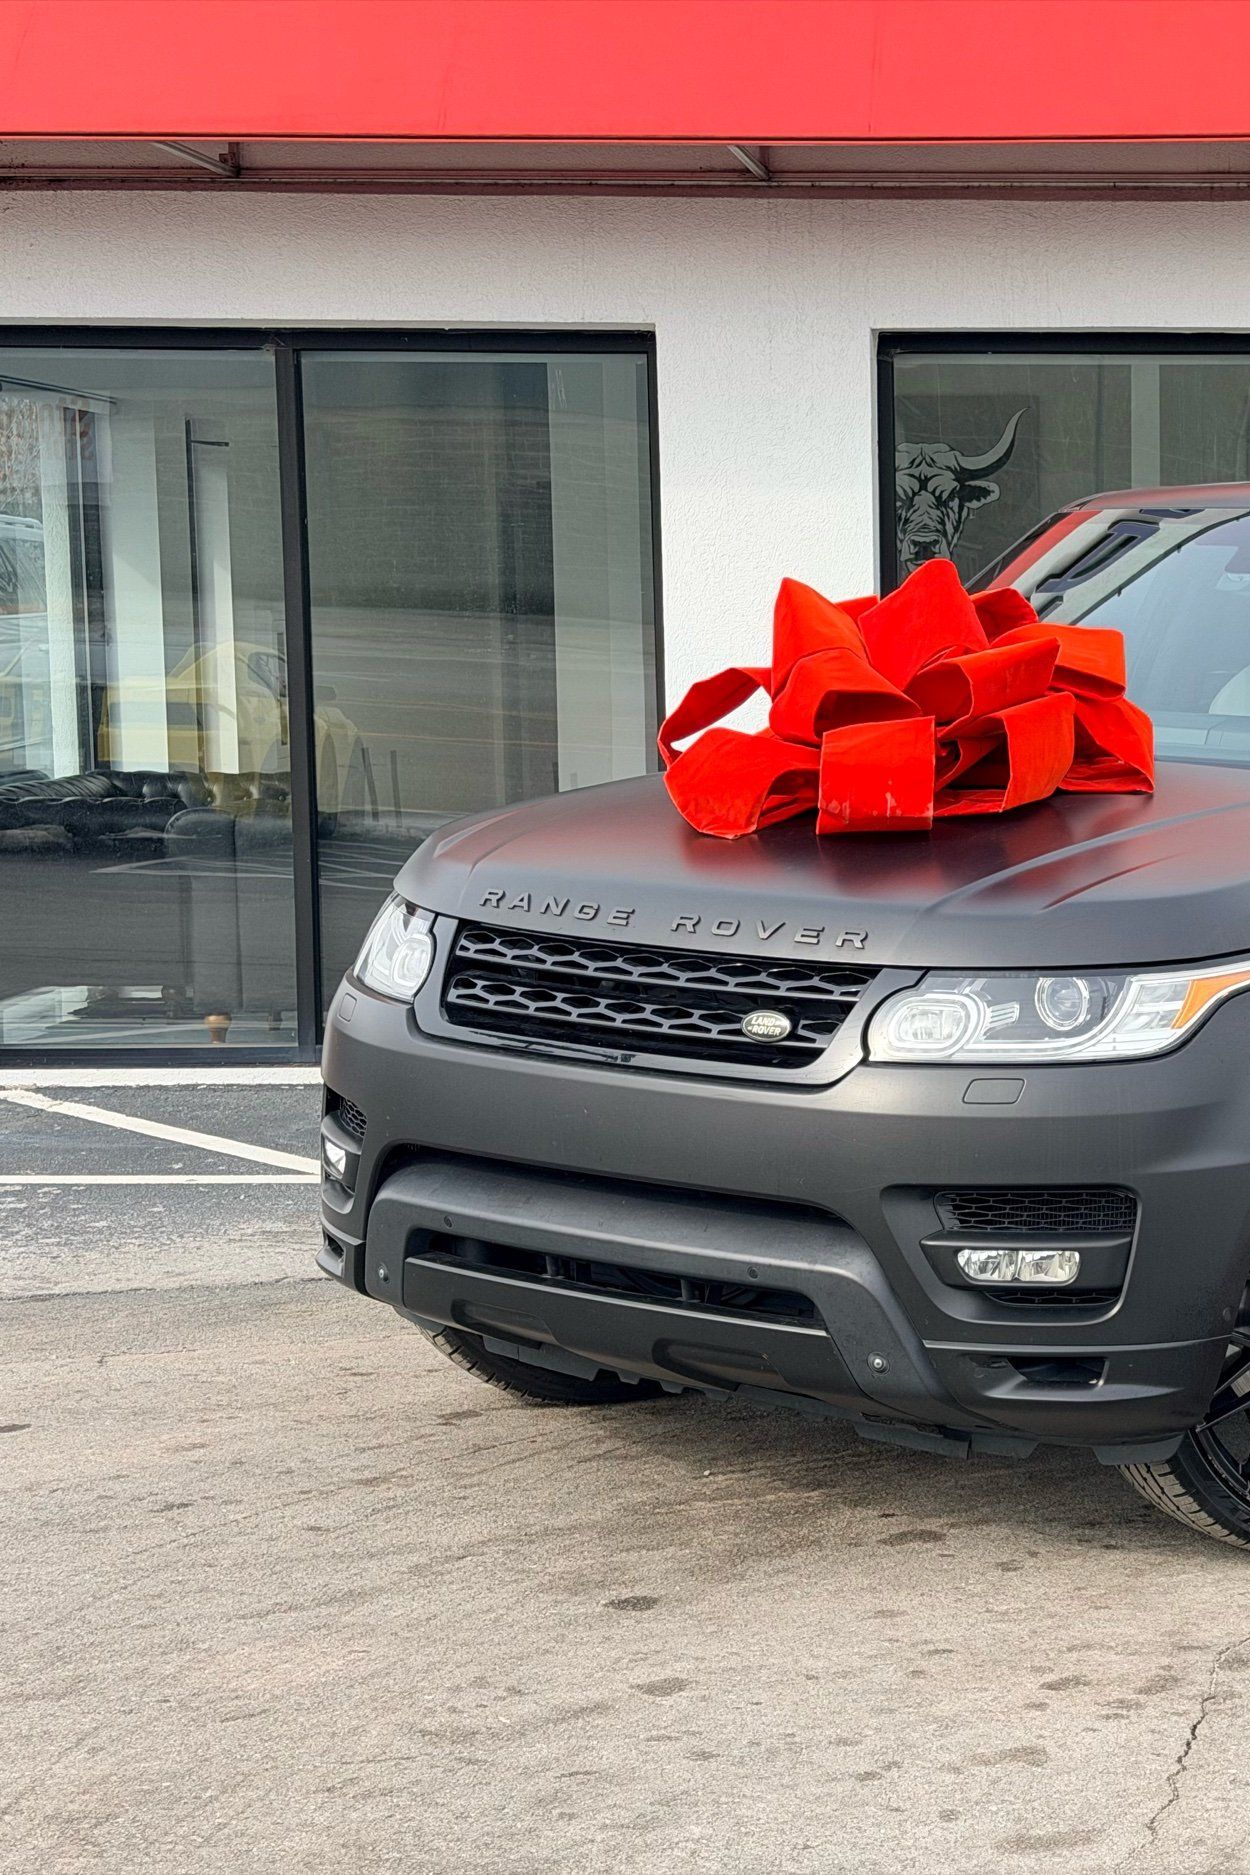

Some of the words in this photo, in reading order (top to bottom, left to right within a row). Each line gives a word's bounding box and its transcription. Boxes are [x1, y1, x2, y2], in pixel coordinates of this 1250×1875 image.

[479, 888, 635, 926] RANGE
[671, 914, 869, 949] ROVER
[751, 1016, 776, 1027] LAND
[751, 1024, 782, 1036] ROVER
